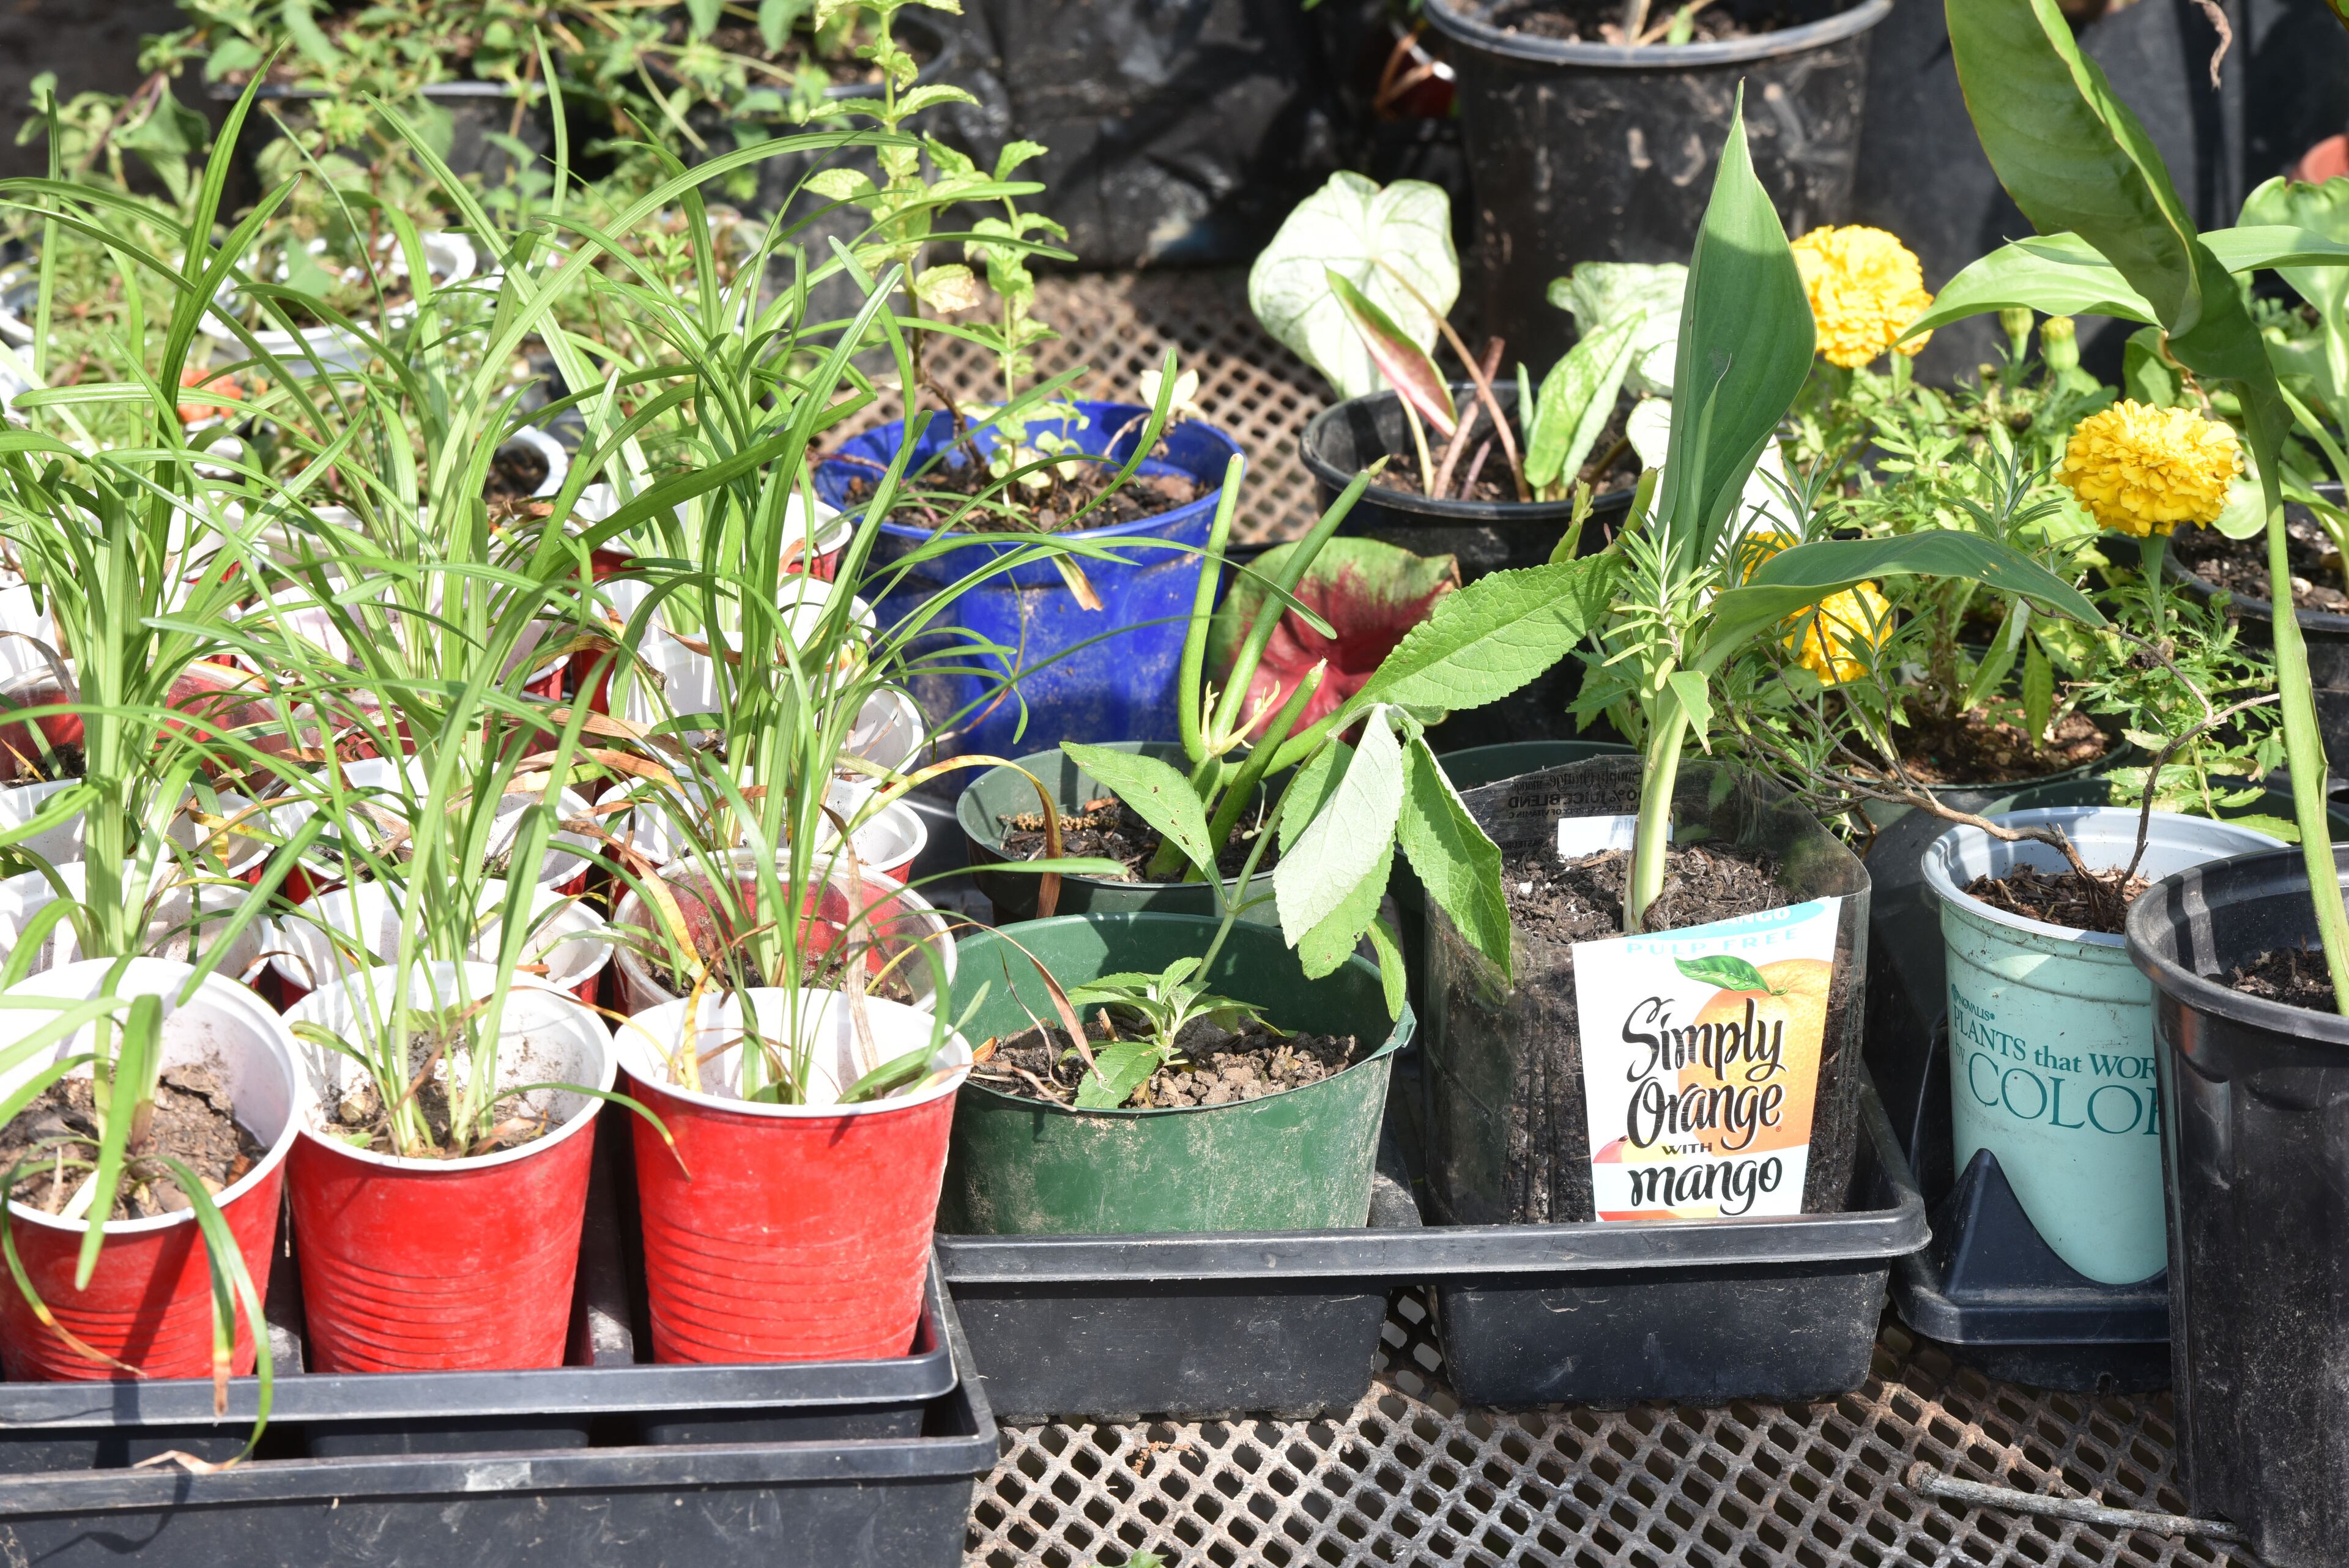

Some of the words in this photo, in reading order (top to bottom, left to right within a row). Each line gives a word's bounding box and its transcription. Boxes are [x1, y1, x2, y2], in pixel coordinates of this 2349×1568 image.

[1713, 907, 1792, 926] ANGO
[1627, 943, 1707, 955] PULP
[1723, 927, 1798, 951] FREE
[1622, 996, 1787, 1082] Simply
[1953, 1003, 2027, 1061] PLANTS
[2033, 1045, 2082, 1072] that
[2088, 1053, 2156, 1079] WOR
[1955, 1033, 1965, 1065] by
[1627, 1076, 1783, 1151] Orange
[1661, 1142, 1713, 1156] WITH
[1627, 1156, 1783, 1216] mango
